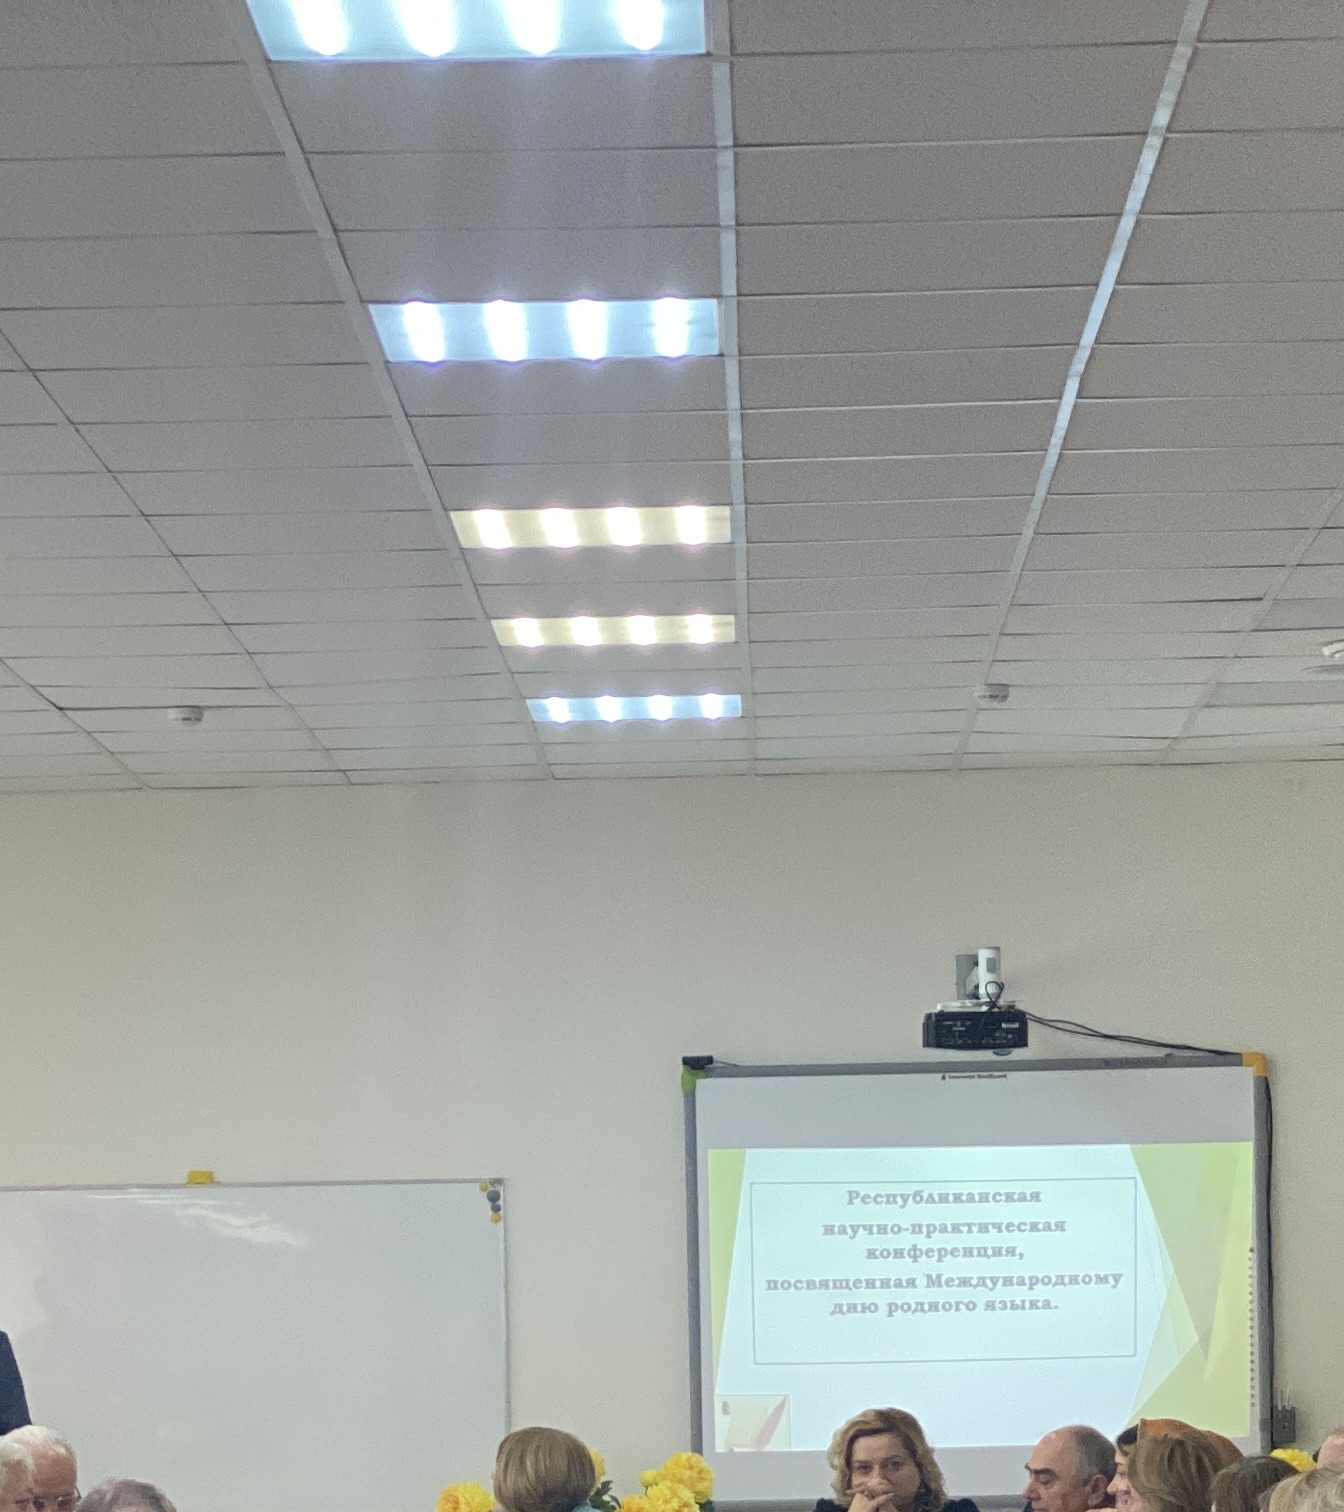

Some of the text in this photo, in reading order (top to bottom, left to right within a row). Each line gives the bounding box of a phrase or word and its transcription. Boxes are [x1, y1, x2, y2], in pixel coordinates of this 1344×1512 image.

[847, 1189, 1042, 1209] Республиканская
[822, 1220, 1067, 1240] научно-практическая
[866, 1243, 1025, 1264] конференция,
[765, 1272, 1124, 1292] посвященная Международному
[830, 1298, 1059, 1317] дню родного языка.
